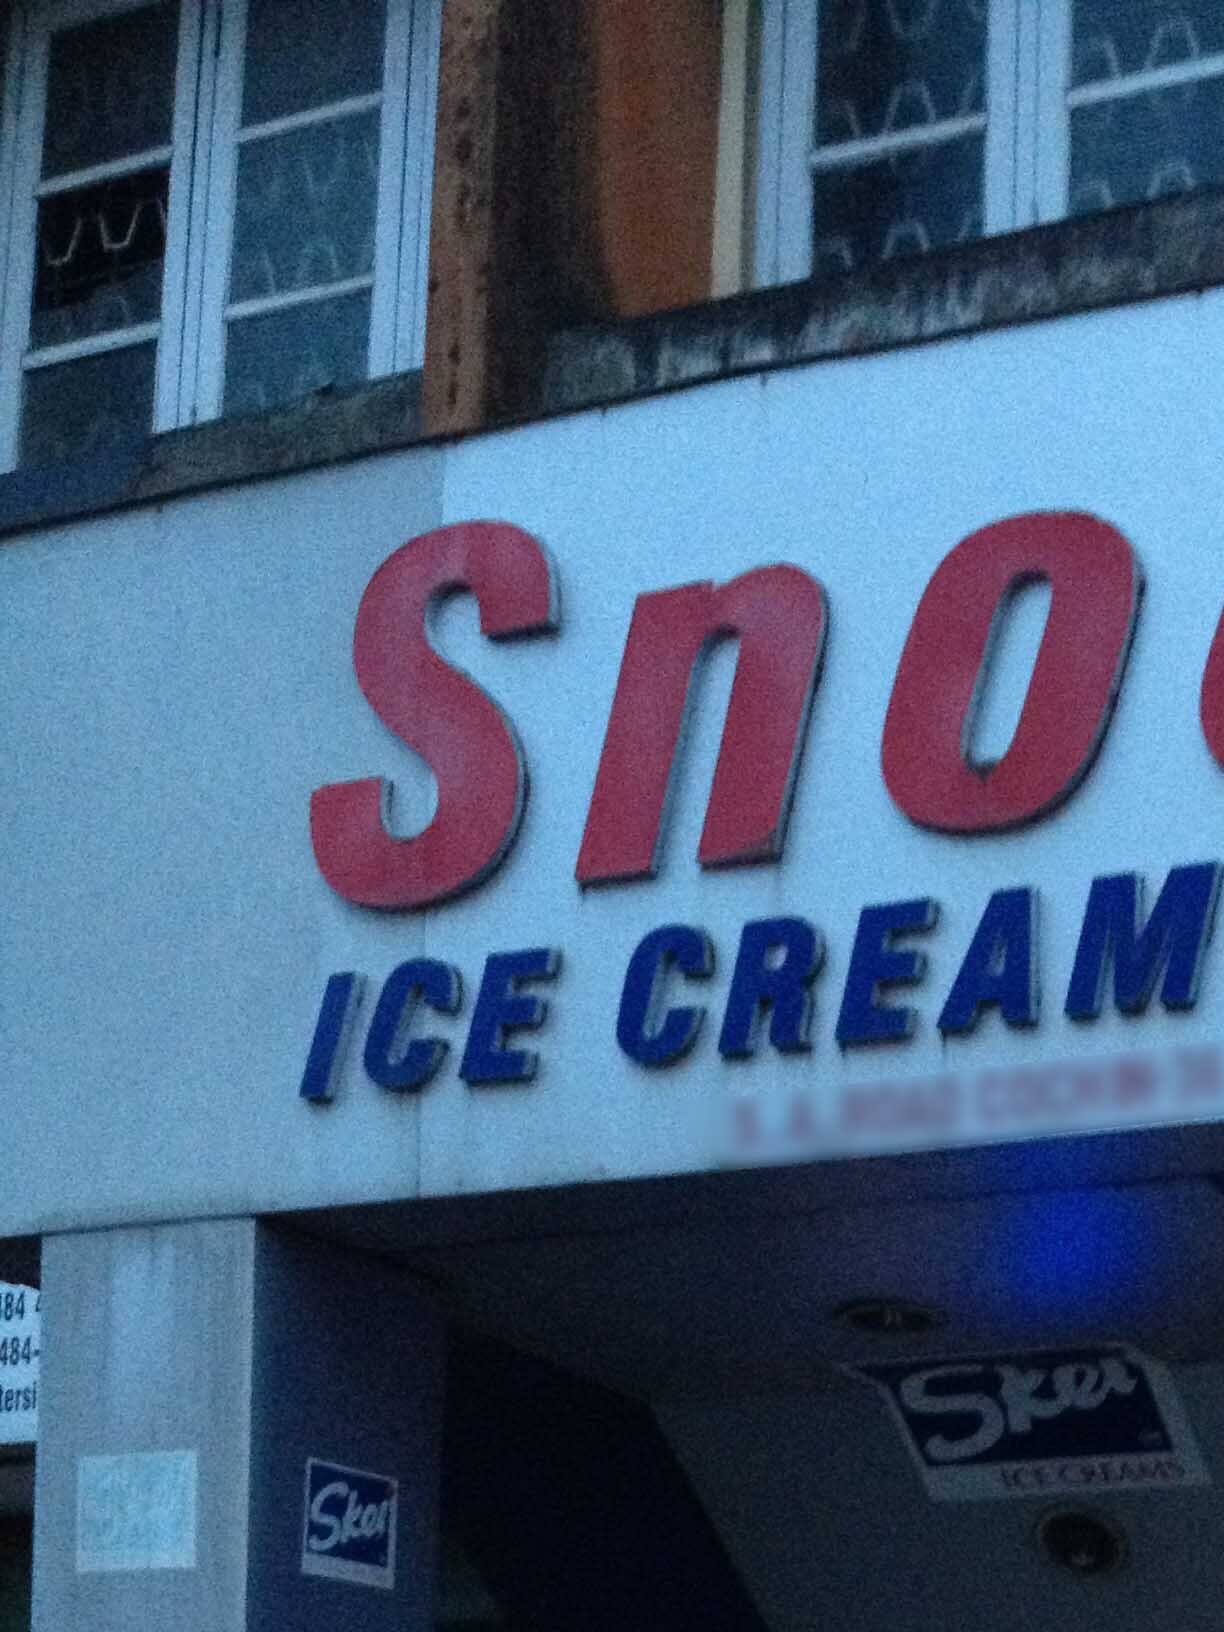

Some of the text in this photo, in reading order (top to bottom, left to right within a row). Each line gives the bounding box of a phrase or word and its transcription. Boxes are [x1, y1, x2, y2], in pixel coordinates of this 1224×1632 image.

[299, 946, 564, 1104] ICE
[0, 1289, 26, 1321] 84
[0, 1380, 37, 1412] ersi
